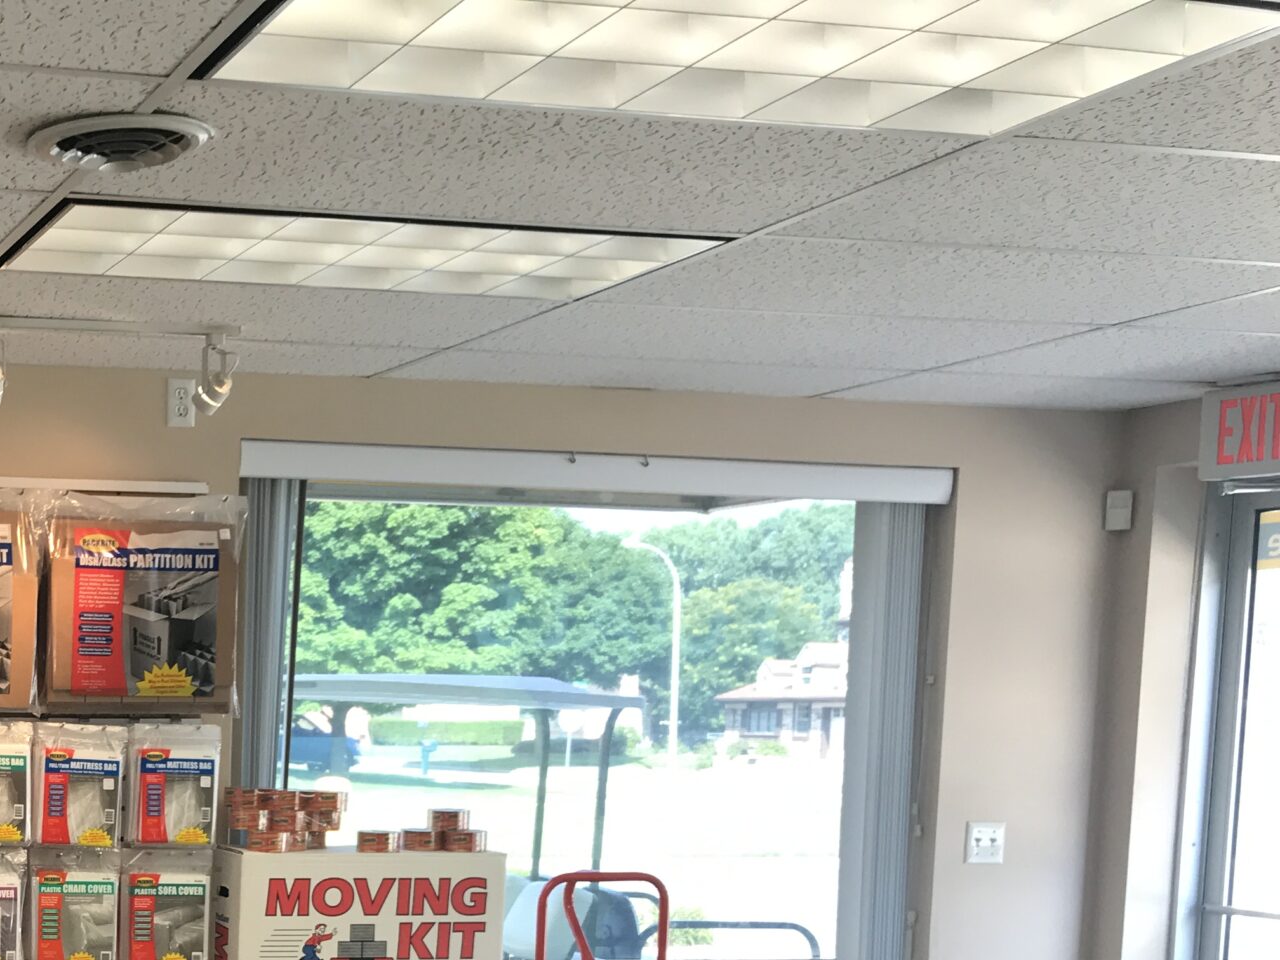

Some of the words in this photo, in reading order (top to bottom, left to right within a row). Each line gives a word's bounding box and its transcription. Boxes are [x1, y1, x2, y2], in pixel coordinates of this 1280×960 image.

[79, 555, 128, 568] DISH/GLASS
[129, 554, 193, 569] PARTITION
[195, 554, 216, 569] KIT
[70, 761, 103, 771] MATTRESS
[103, 762, 117, 771] BAG
[62, 884, 86, 893] CHAIR
[87, 884, 113, 894] COVER
[158, 885, 178, 895] SOFA
[178, 886, 203, 895] COVER
[265, 877, 488, 917] MOVING
[396, 921, 486, 960] KIT
